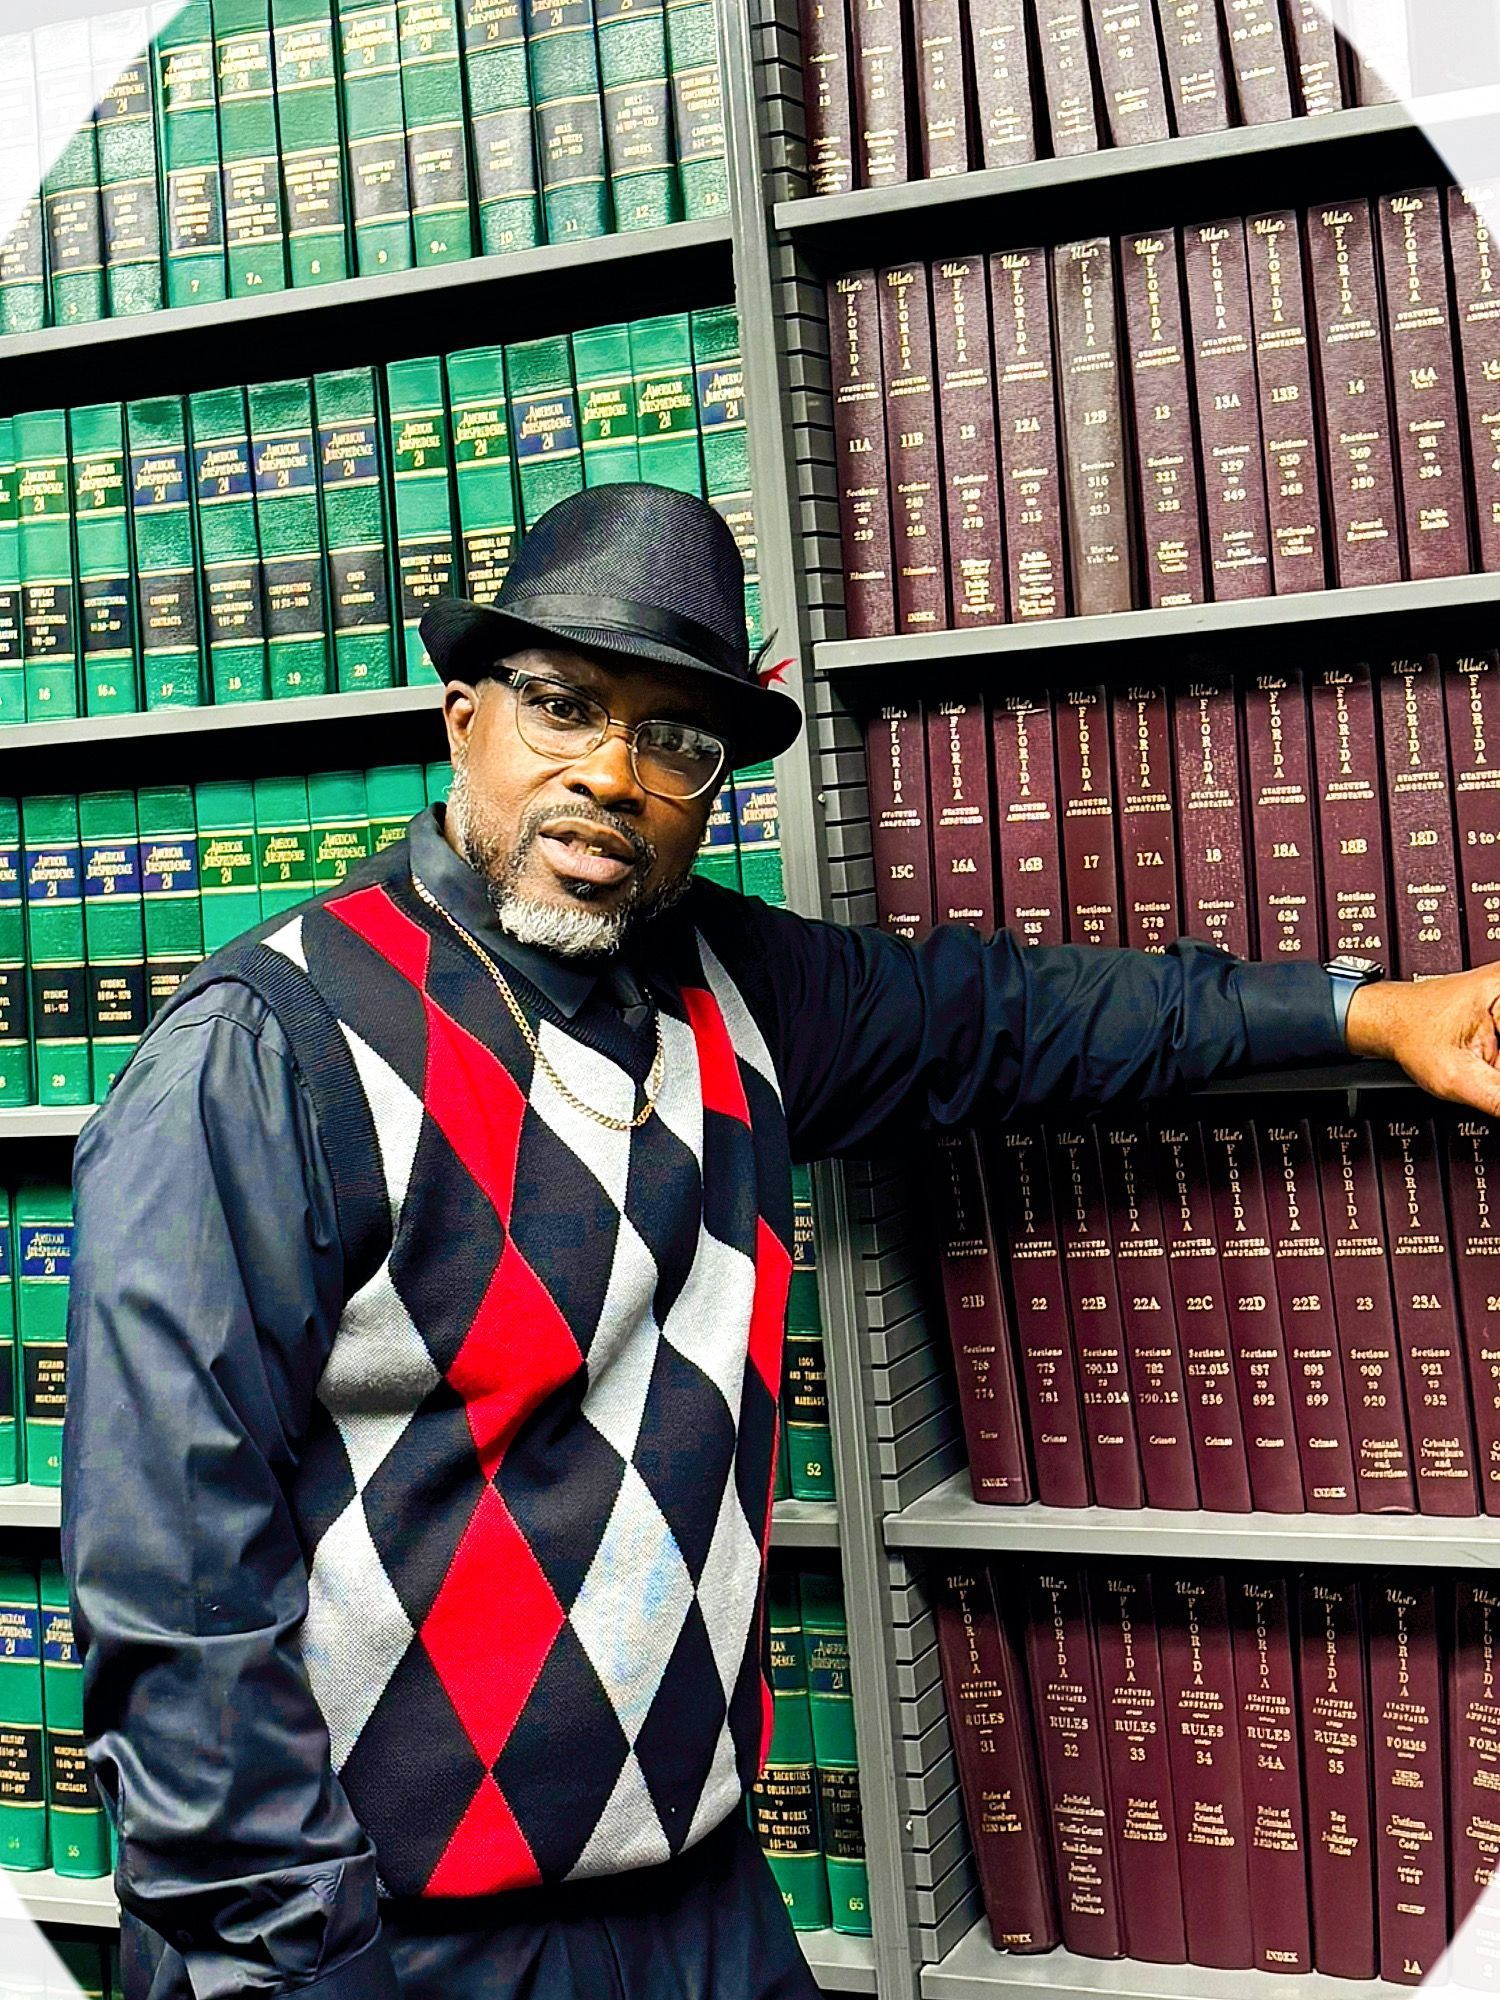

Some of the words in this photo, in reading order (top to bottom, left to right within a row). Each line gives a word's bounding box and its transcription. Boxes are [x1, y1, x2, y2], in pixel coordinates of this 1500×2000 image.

[1404, 214, 1419, 301] FLORIDA
[1335, 228, 1351, 315] FLORIDA
[1082, 262, 1095, 346] FLORIDA
[1013, 271, 1027, 355] FLORIDA
[898, 287, 911, 370] FLORIDA
[847, 295, 859, 377] FLORIDA
[1410, 367, 1438, 382] 14A
[1348, 381, 1365, 394] 14
[1084, 411, 1107, 425] 12B
[960, 425, 976, 439] 12
[1015, 419, 1040, 433] 12A
[849, 439, 872, 452] 11A
[901, 432, 923, 447] 11B
[355, 665, 367, 677] 20
[1337, 687, 1352, 774] FLORIDA
[1079, 707, 1092, 791] FLORIDA
[1138, 703, 1151, 788] FLORIDA
[891, 721, 903, 803] FLORIDA
[950, 716, 963, 799] FLORIDA
[1409, 831, 1438, 845] 18D
[1273, 843, 1299, 857] 18A
[1340, 839, 1367, 853] 18B
[1084, 856, 1099, 869] 17
[1137, 853, 1163, 866] 17A
[1206, 849, 1222, 862] 18
[952, 860, 977, 872] 16A
[1019, 857, 1043, 871] 16B
[891, 865, 914, 878] 15C
[1084, 920, 1104, 931] 561
[1143, 917, 1164, 928] 578
[1206, 915, 1227, 926] 607
[52, 1075, 65, 1086] 29
[1174, 1145, 1192, 1232] FLORIDA
[1227, 1143, 1246, 1231] FLORIDA
[1282, 1143, 1300, 1231] FLORIDA
[1403, 1138, 1420, 1228] FLORIDA
[962, 1295, 985, 1308] 21B
[1032, 1298, 1048, 1310] 22
[1082, 1297, 1107, 1310] 22B
[1133, 1297, 1161, 1310] 22A
[1187, 1296, 1213, 1311] 22C
[1238, 1297, 1266, 1310] 22D
[1293, 1296, 1320, 1310] 22E
[1356, 1298, 1373, 1310] 23
[1412, 1295, 1441, 1309] 23A
[1037, 1363, 1055, 1374] 775
[1360, 1365, 1382, 1377] 900
[1421, 1364, 1442, 1375] 921
[1363, 1394, 1386, 1407] 920
[807, 1463, 821, 1476] 52
[1049, 1716, 1089, 1729] RULES
[1115, 1720, 1156, 1733] RULES
[1181, 1723, 1224, 1737] RULES
[1247, 1726, 1291, 1742] RULES
[980, 1740, 996, 1752] 31
[1314, 1731, 1357, 1747] RULES
[1064, 1744, 1079, 1757] 32
[1130, 1748, 1145, 1761] 33
[1196, 1751, 1213, 1765] 34
[1258, 1755, 1285, 1770] 34A
[849, 1898, 863, 1910] 65
